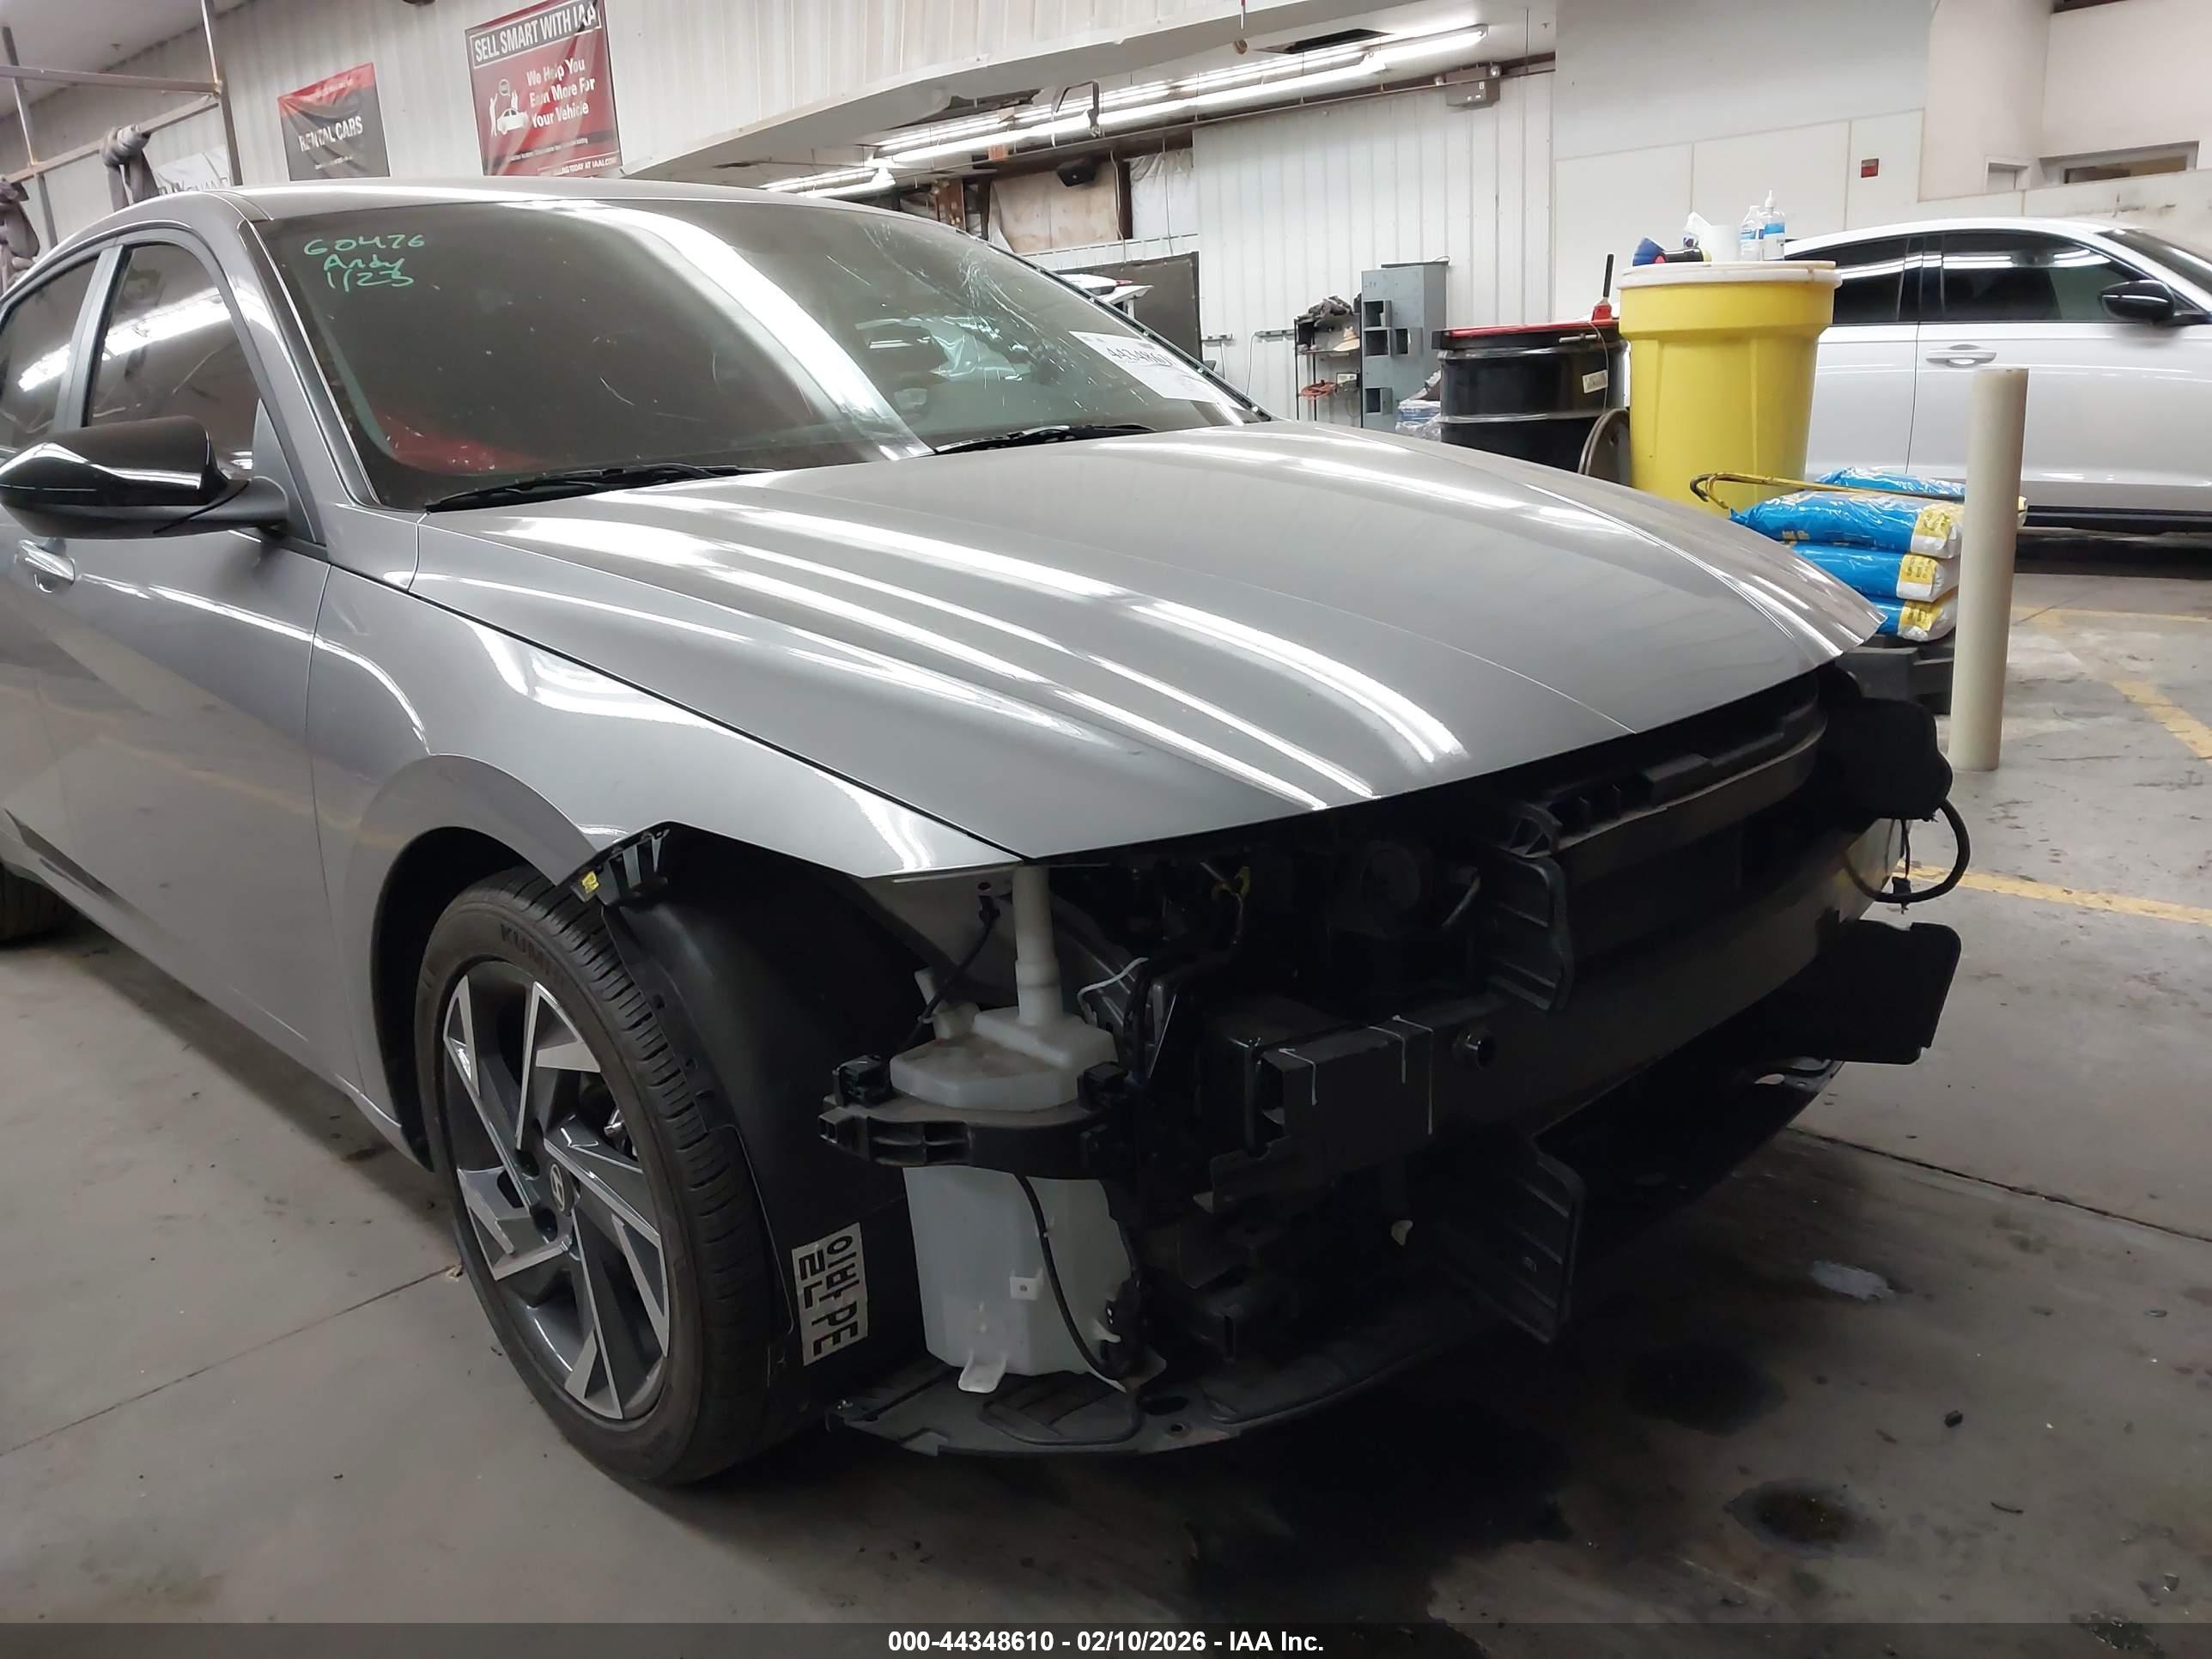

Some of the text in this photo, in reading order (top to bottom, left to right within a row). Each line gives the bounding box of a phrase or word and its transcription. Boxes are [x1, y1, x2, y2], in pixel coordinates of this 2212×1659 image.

[475, 3, 597, 62] SELL SMART WITH IAA
[526, 58, 586, 87] We Help You
[550, 84, 577, 102] More
[580, 76, 596, 93] For
[335, 115, 363, 140] CARS
[531, 101, 589, 128] Your Vehicle
[304, 234, 425, 255] 60476
